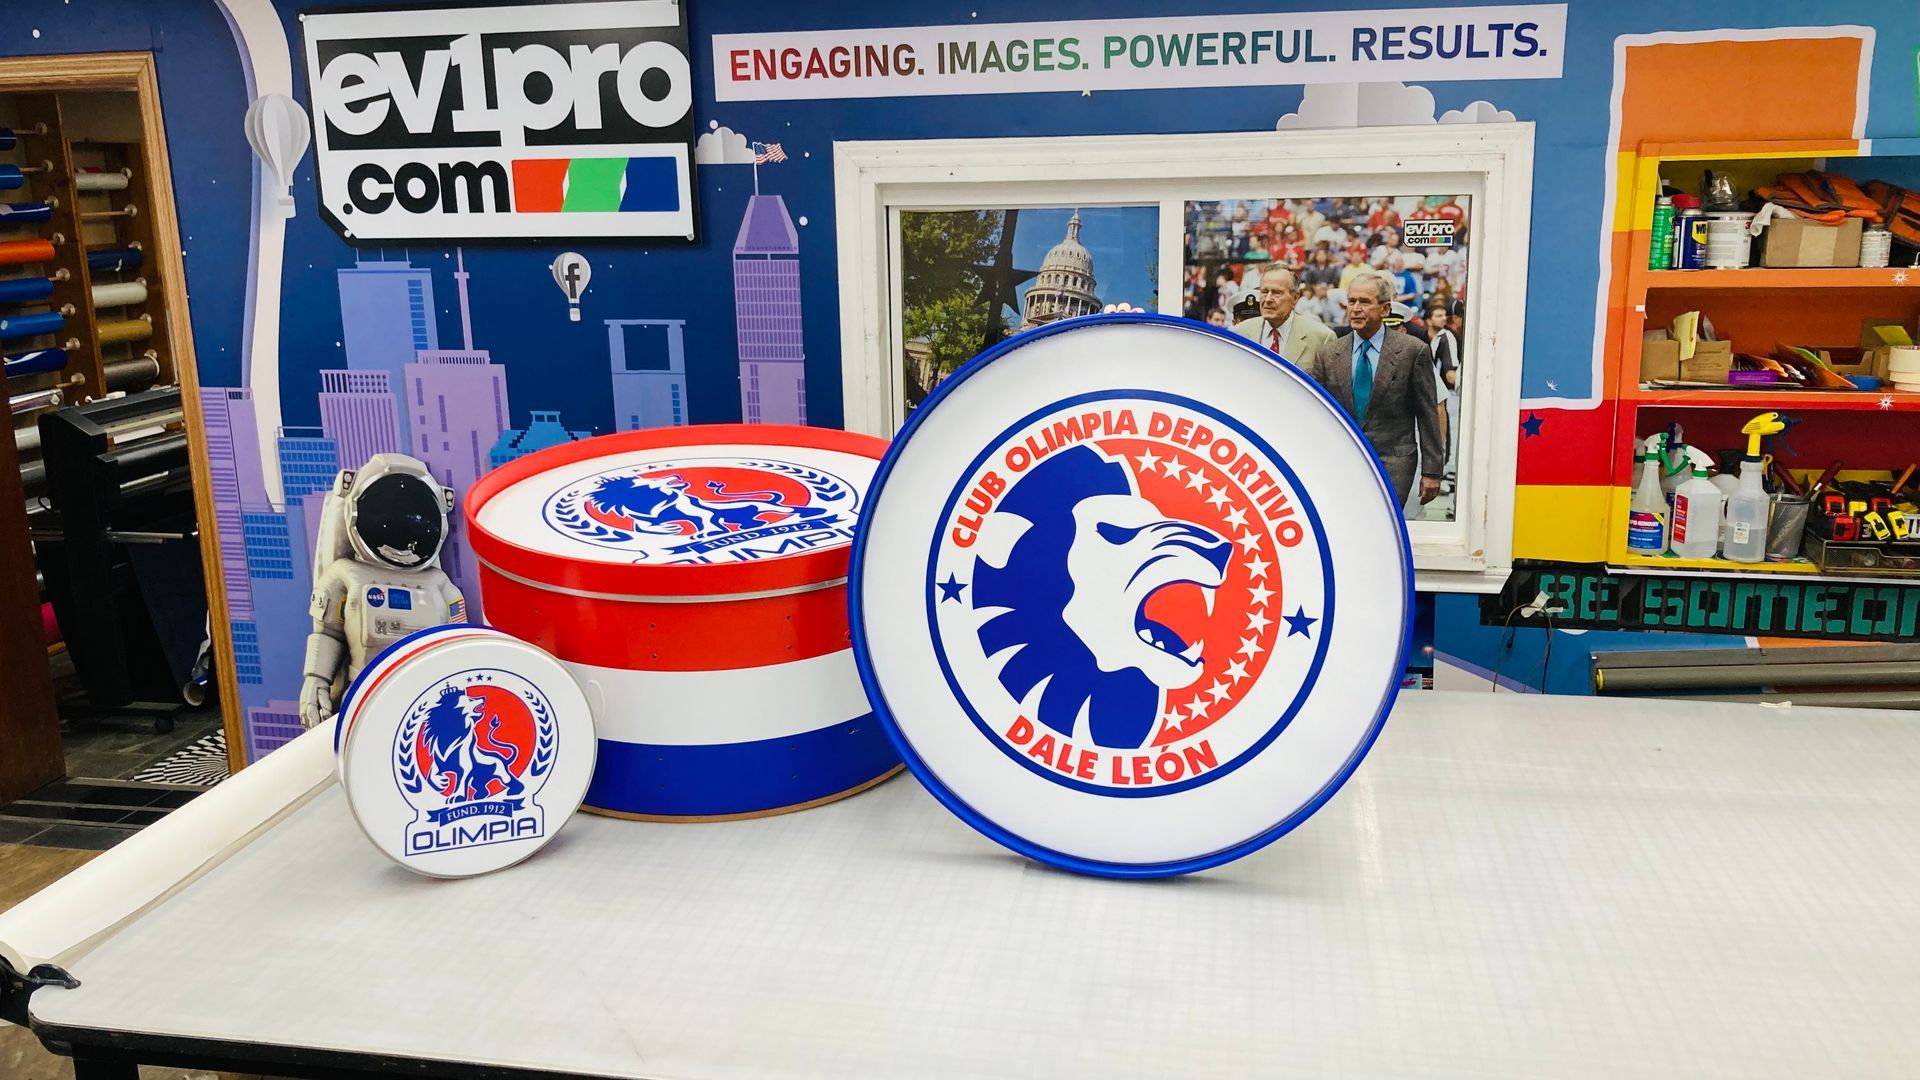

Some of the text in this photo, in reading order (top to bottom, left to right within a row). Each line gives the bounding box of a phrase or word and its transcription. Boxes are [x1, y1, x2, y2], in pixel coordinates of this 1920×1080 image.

[730, 22, 1547, 82] ENGAGING. IMAGES. POWERFUL. RESULTS.
[343, 160, 511, 214] .com
[952, 409, 1303, 548] CLUB OLIMPIA DEPORTIVO
[704, 523, 813, 549] FUND. 1912
[1540, 575, 1618, 620] BE
[1005, 714, 1219, 786] DALE LEÓN
[413, 817, 537, 850] OLIMPIA
[447, 804, 505, 821] FUND. 1912
